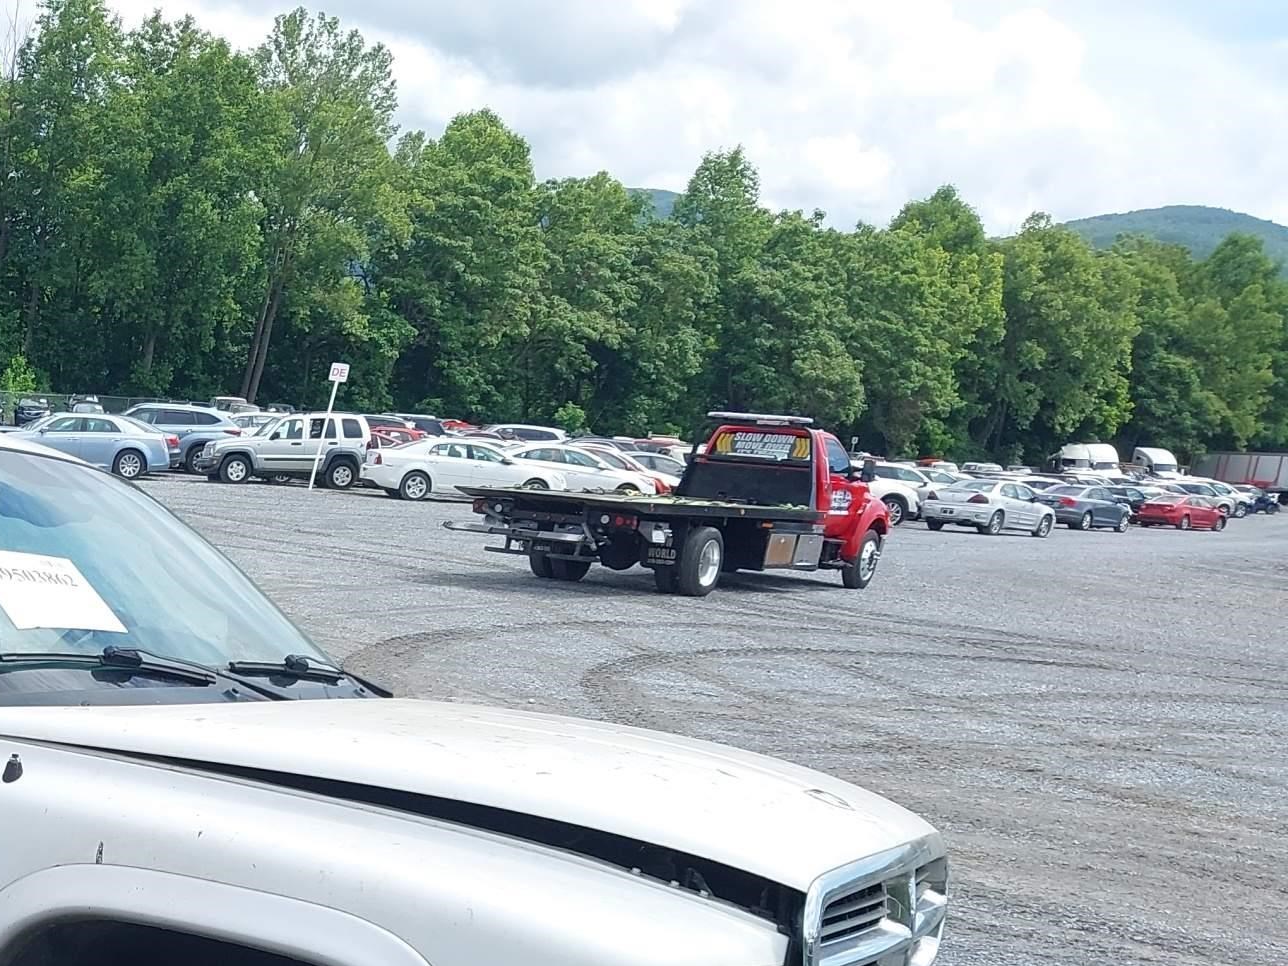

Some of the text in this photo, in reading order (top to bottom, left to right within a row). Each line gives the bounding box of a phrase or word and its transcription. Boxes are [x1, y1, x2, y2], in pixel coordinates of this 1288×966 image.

[332, 368, 347, 377] DE
[734, 432, 796, 444] SLOW DOWN
[736, 442, 762, 450] MOVE
[648, 548, 676, 559] WORLD
